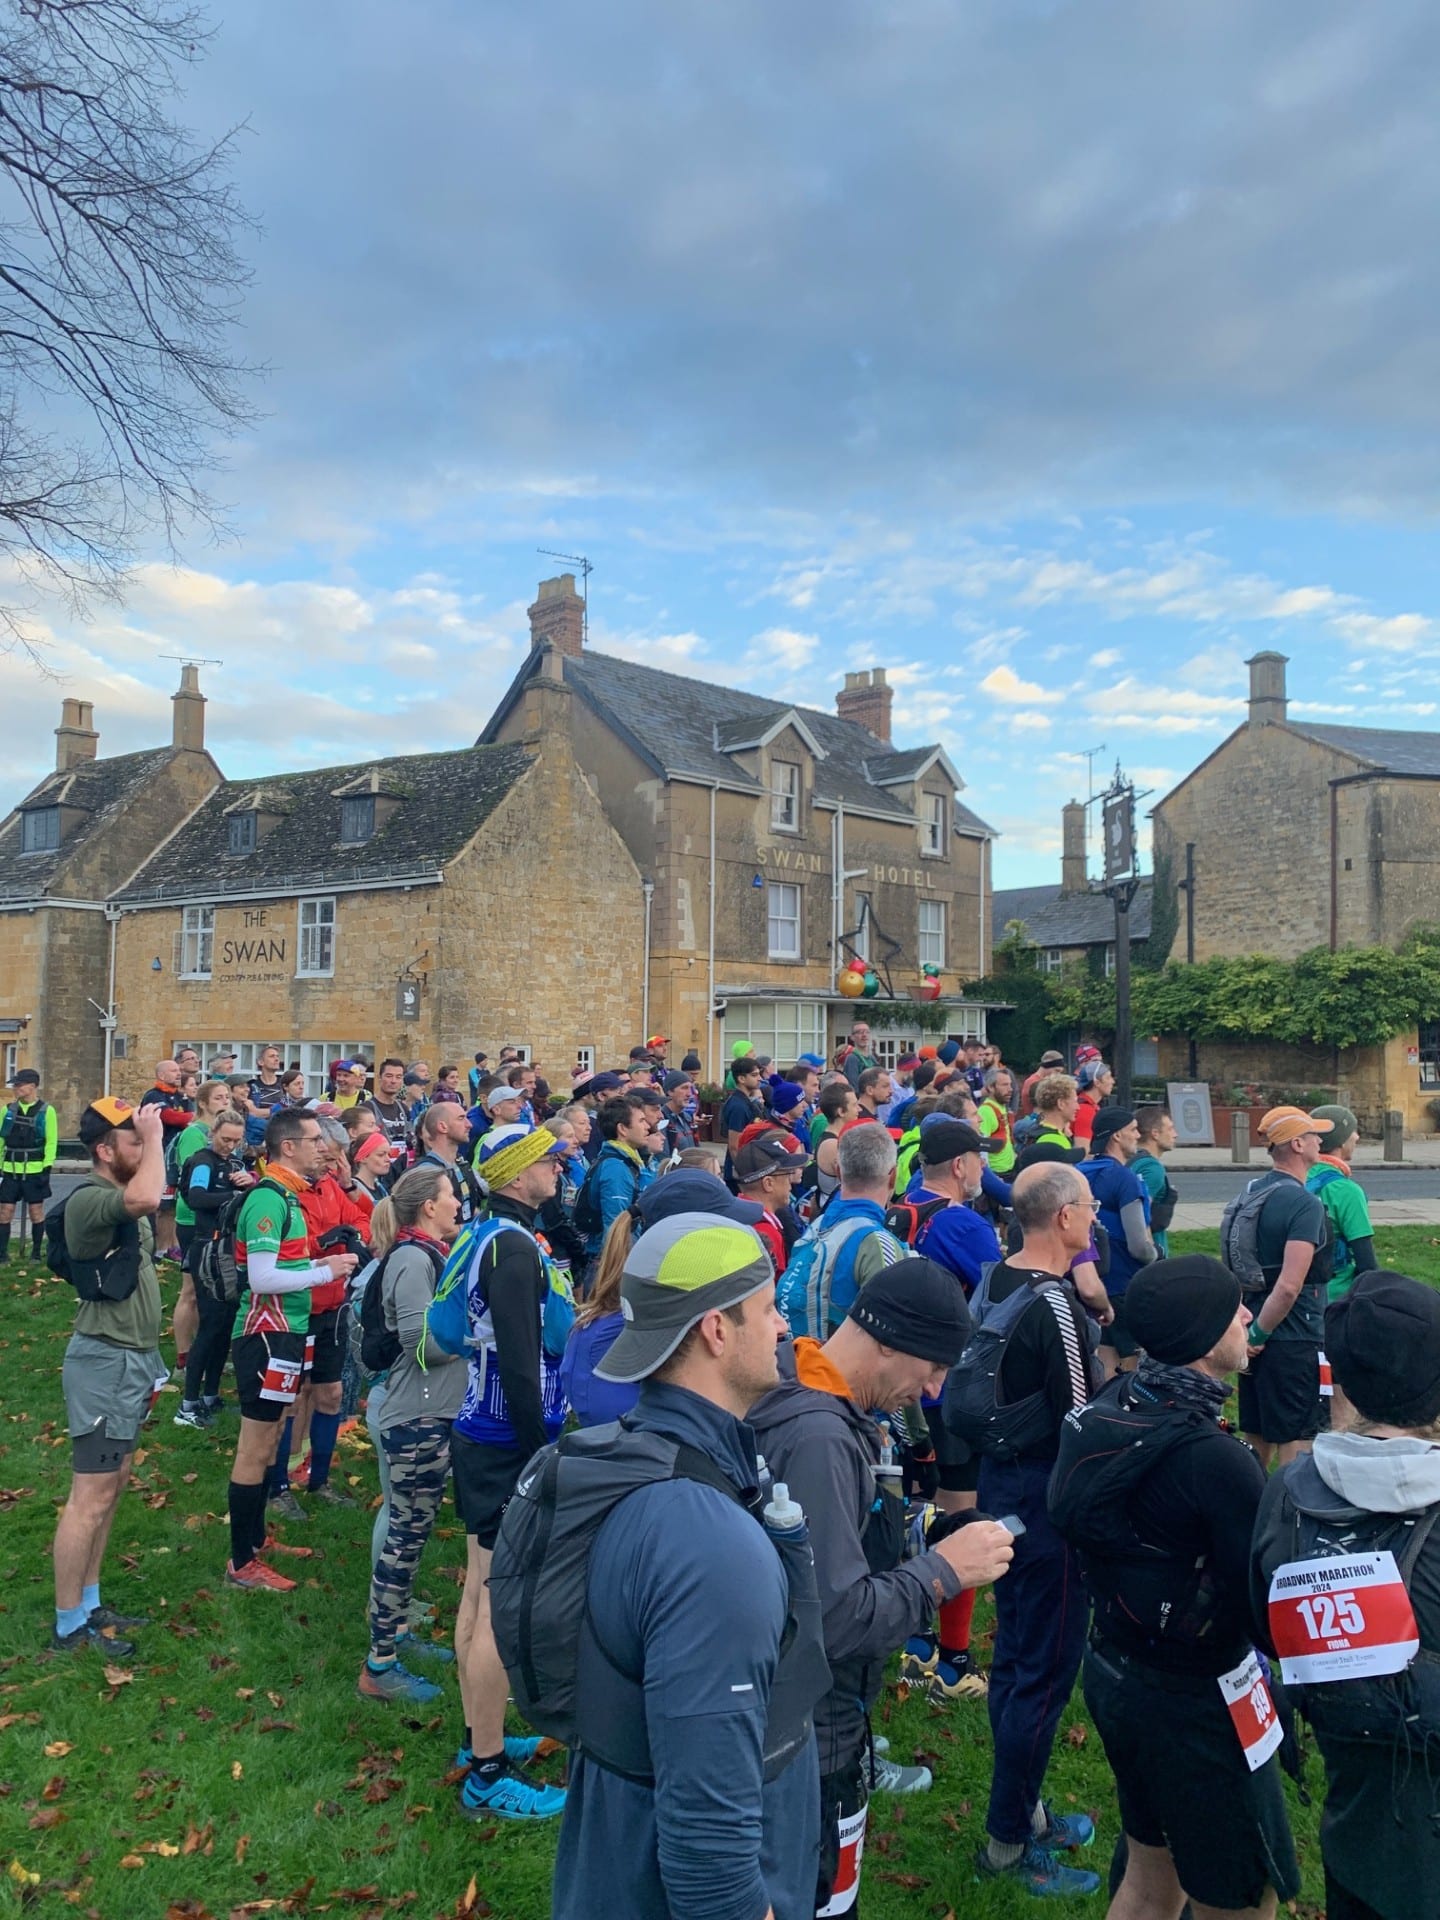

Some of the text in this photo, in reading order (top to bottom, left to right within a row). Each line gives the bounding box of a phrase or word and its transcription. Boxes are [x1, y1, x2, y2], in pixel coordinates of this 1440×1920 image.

[756, 847, 937, 889] SWAN HOTEL
[243, 910, 267, 928] THE
[223, 938, 286, 964] SWAN
[1276, 1564, 1375, 1590] BROADWAY MARATHON
[1311, 1583, 1331, 1593] 2024
[1296, 1592, 1366, 1640] 125
